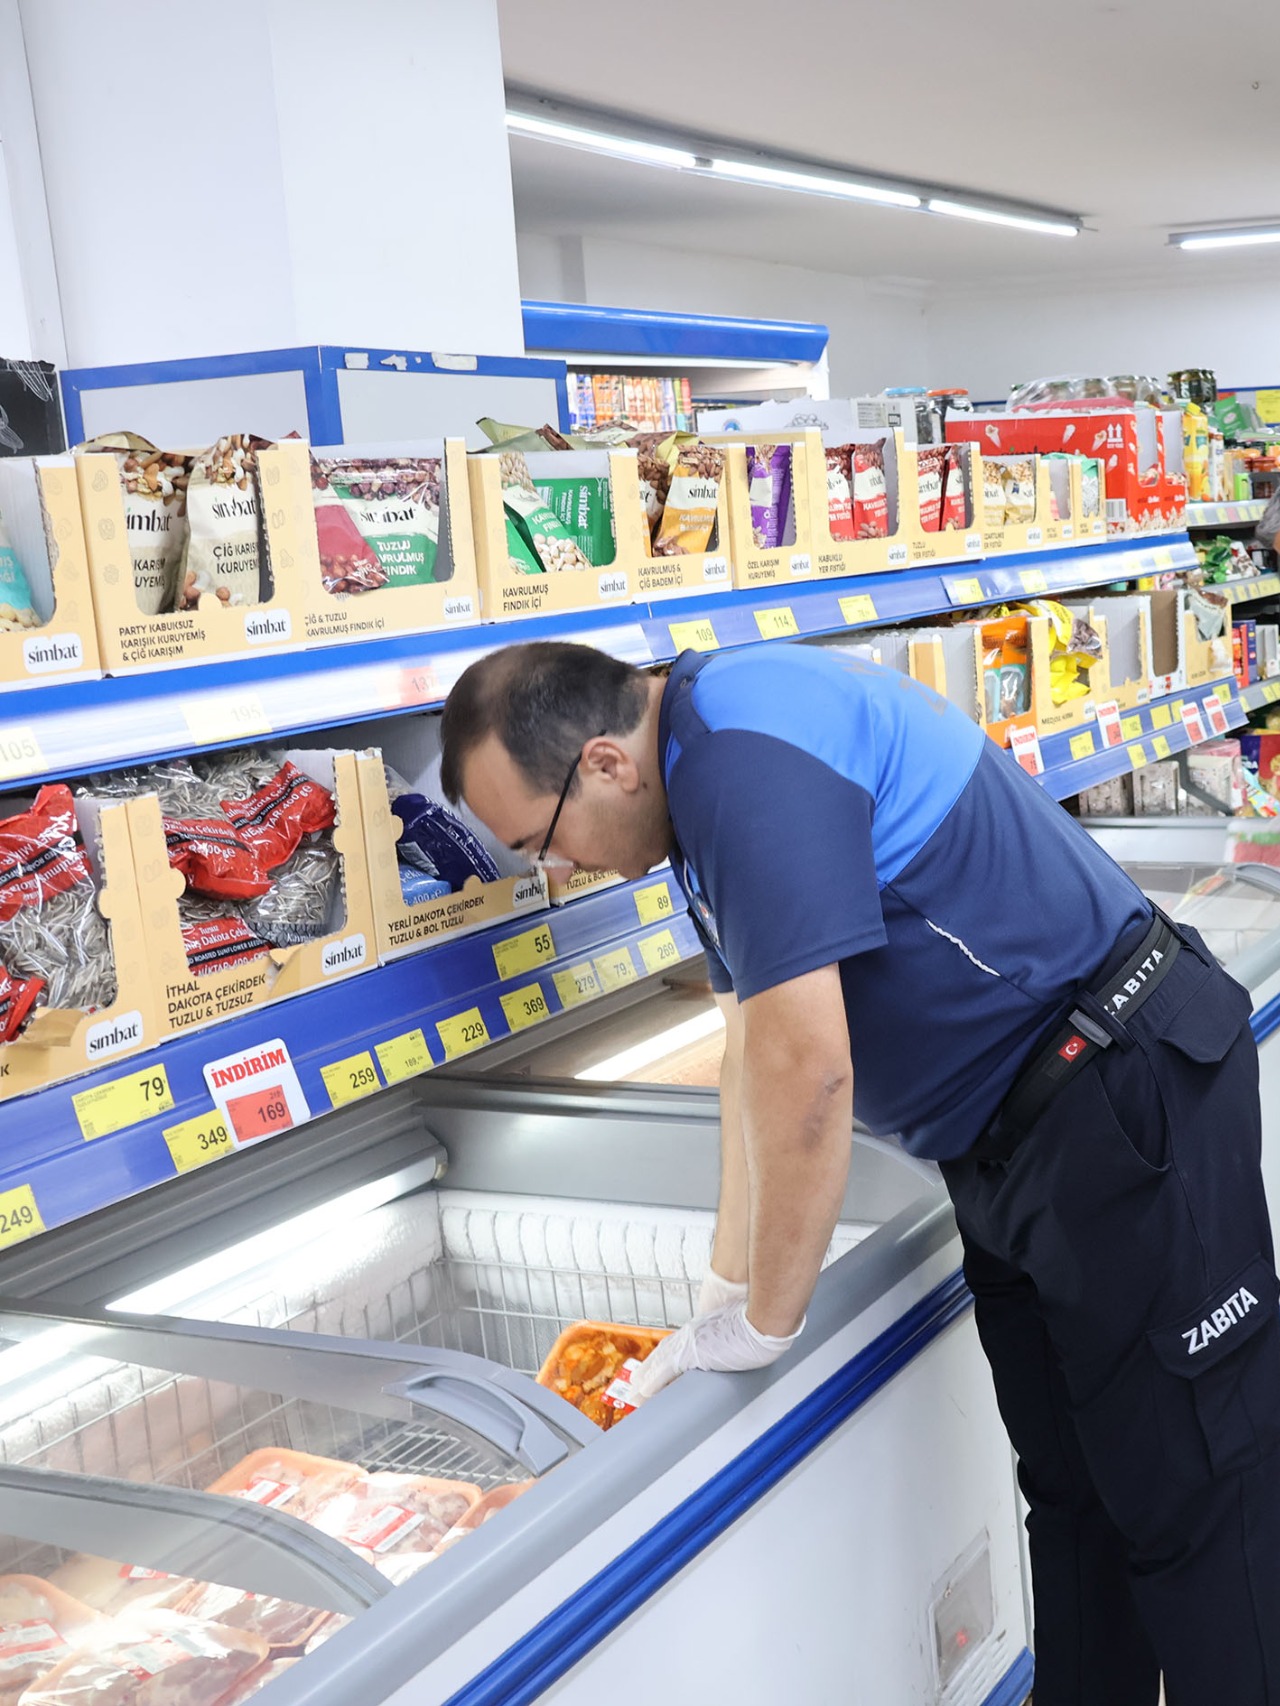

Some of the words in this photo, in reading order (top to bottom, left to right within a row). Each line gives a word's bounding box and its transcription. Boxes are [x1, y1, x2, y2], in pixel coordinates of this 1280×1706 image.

[127, 507, 172, 532] imbat
[379, 552, 425, 565] VRULMUŞ
[638, 564, 676, 578] KAVRULMUŞ
[652, 575, 674, 588] BADEM
[503, 583, 549, 598] KAVRULMUŞ
[600, 576, 626, 594] simbat
[445, 598, 471, 615] simbat
[504, 599, 531, 611] FINDIK
[246, 616, 287, 637] simbat
[325, 611, 347, 623] TUZLU
[350, 620, 374, 632] FINDIK
[119, 624, 146, 637] PARTY
[149, 619, 194, 633] KABUKSUZ
[696, 626, 713, 642] 109
[120, 634, 157, 649] KARIŞIK
[158, 629, 206, 646] KURUYEMİŞ
[28, 644, 79, 666] simbat
[122, 652, 129, 662] &
[148, 645, 184, 660] KARIŞIM
[388, 916, 411, 932] YERLİ
[413, 908, 445, 927] DAKOTA
[447, 895, 485, 915] ÇEKİRDEK
[657, 896, 669, 910] 89
[389, 930, 415, 946] TUZLU
[424, 924, 439, 936] BOL
[441, 916, 464, 931] TUZLU
[535, 933, 551, 953] 55
[657, 942, 675, 961] 269
[325, 943, 364, 969] simbat
[166, 980, 200, 999] İTHAL
[168, 993, 212, 1014] DAKOTA
[215, 973, 266, 1000] ÇEKİRDEK
[169, 1008, 203, 1029] TUZLU
[206, 1005, 214, 1017] &
[216, 992, 254, 1014] TUZSUZ
[523, 996, 545, 1017] 369
[89, 1025, 139, 1054] simbat
[462, 1021, 485, 1043] 229
[211, 1049, 287, 1089] İNDİRİM
[349, 1066, 375, 1089] 259
[140, 1076, 164, 1101] 79
[258, 1102, 285, 1123] 169
[197, 1126, 227, 1150] 349
[0, 1205, 33, 1234] 249
[1181, 1286, 1259, 1355] ZABITA
